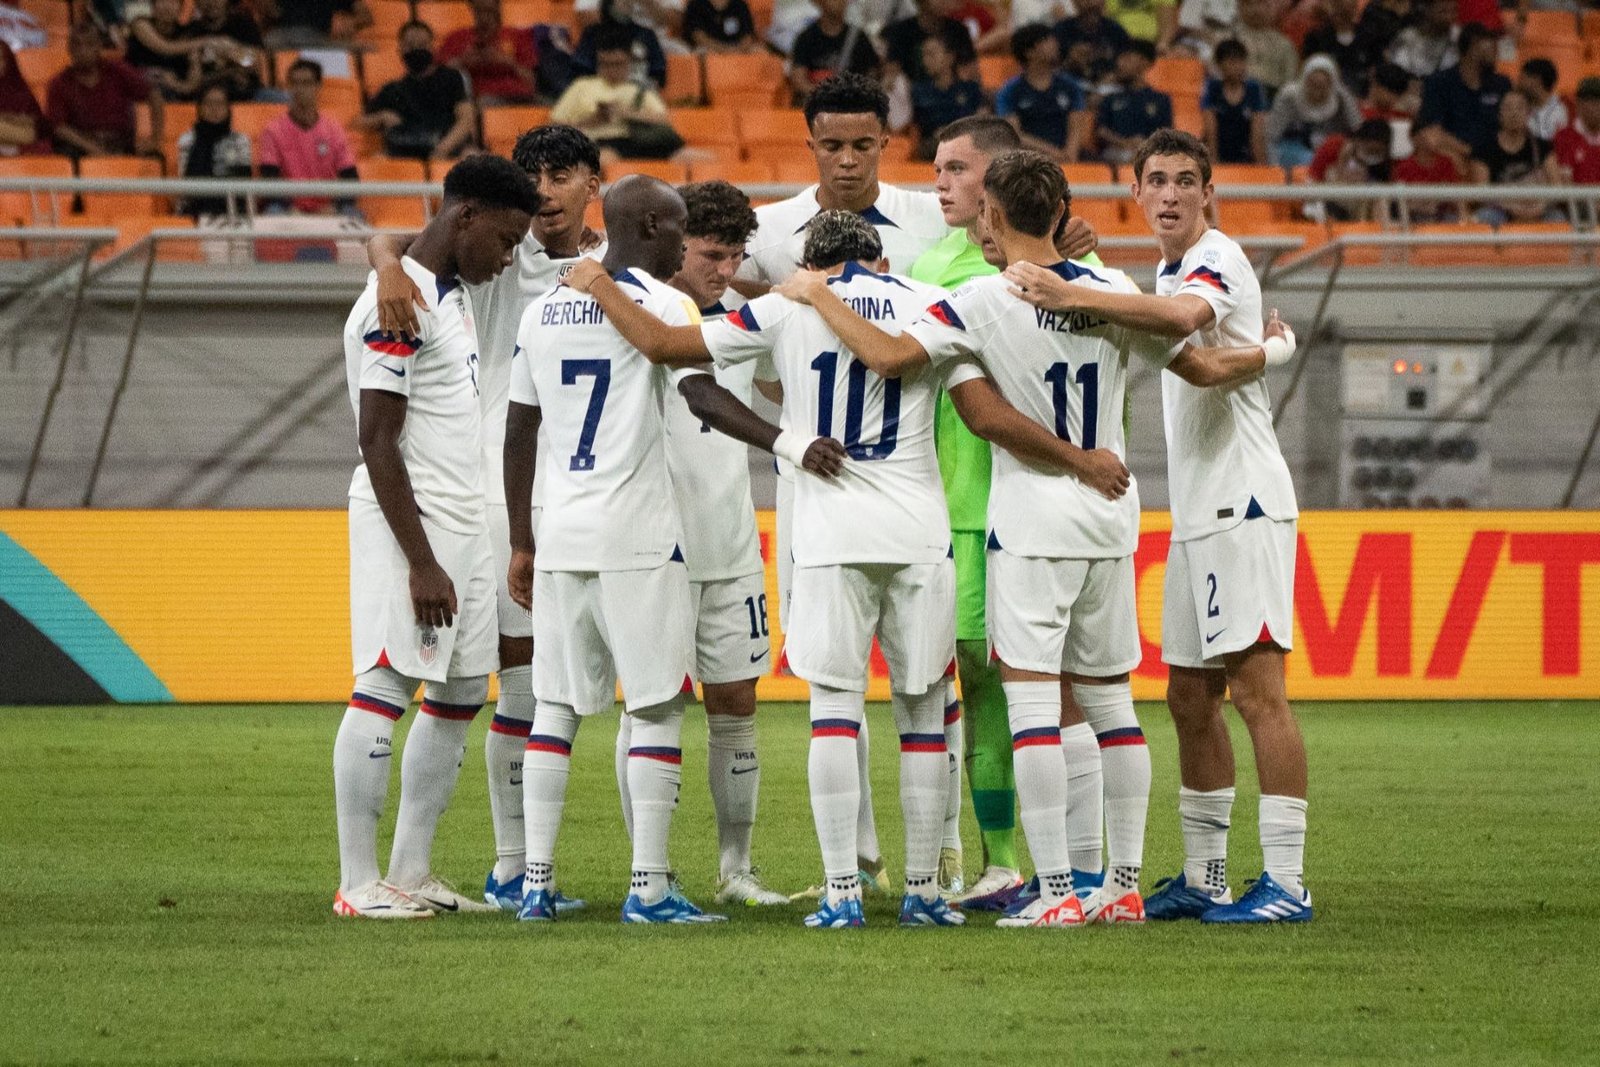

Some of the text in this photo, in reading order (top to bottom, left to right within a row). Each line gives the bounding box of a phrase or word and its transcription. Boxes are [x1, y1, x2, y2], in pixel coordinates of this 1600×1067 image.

[541, 299, 644, 326] BERCHI
[561, 358, 612, 472] 7
[811, 351, 902, 462] 10
[1044, 361, 1099, 451] 11
[1206, 572, 1220, 618] 2
[734, 751, 756, 761] USA
